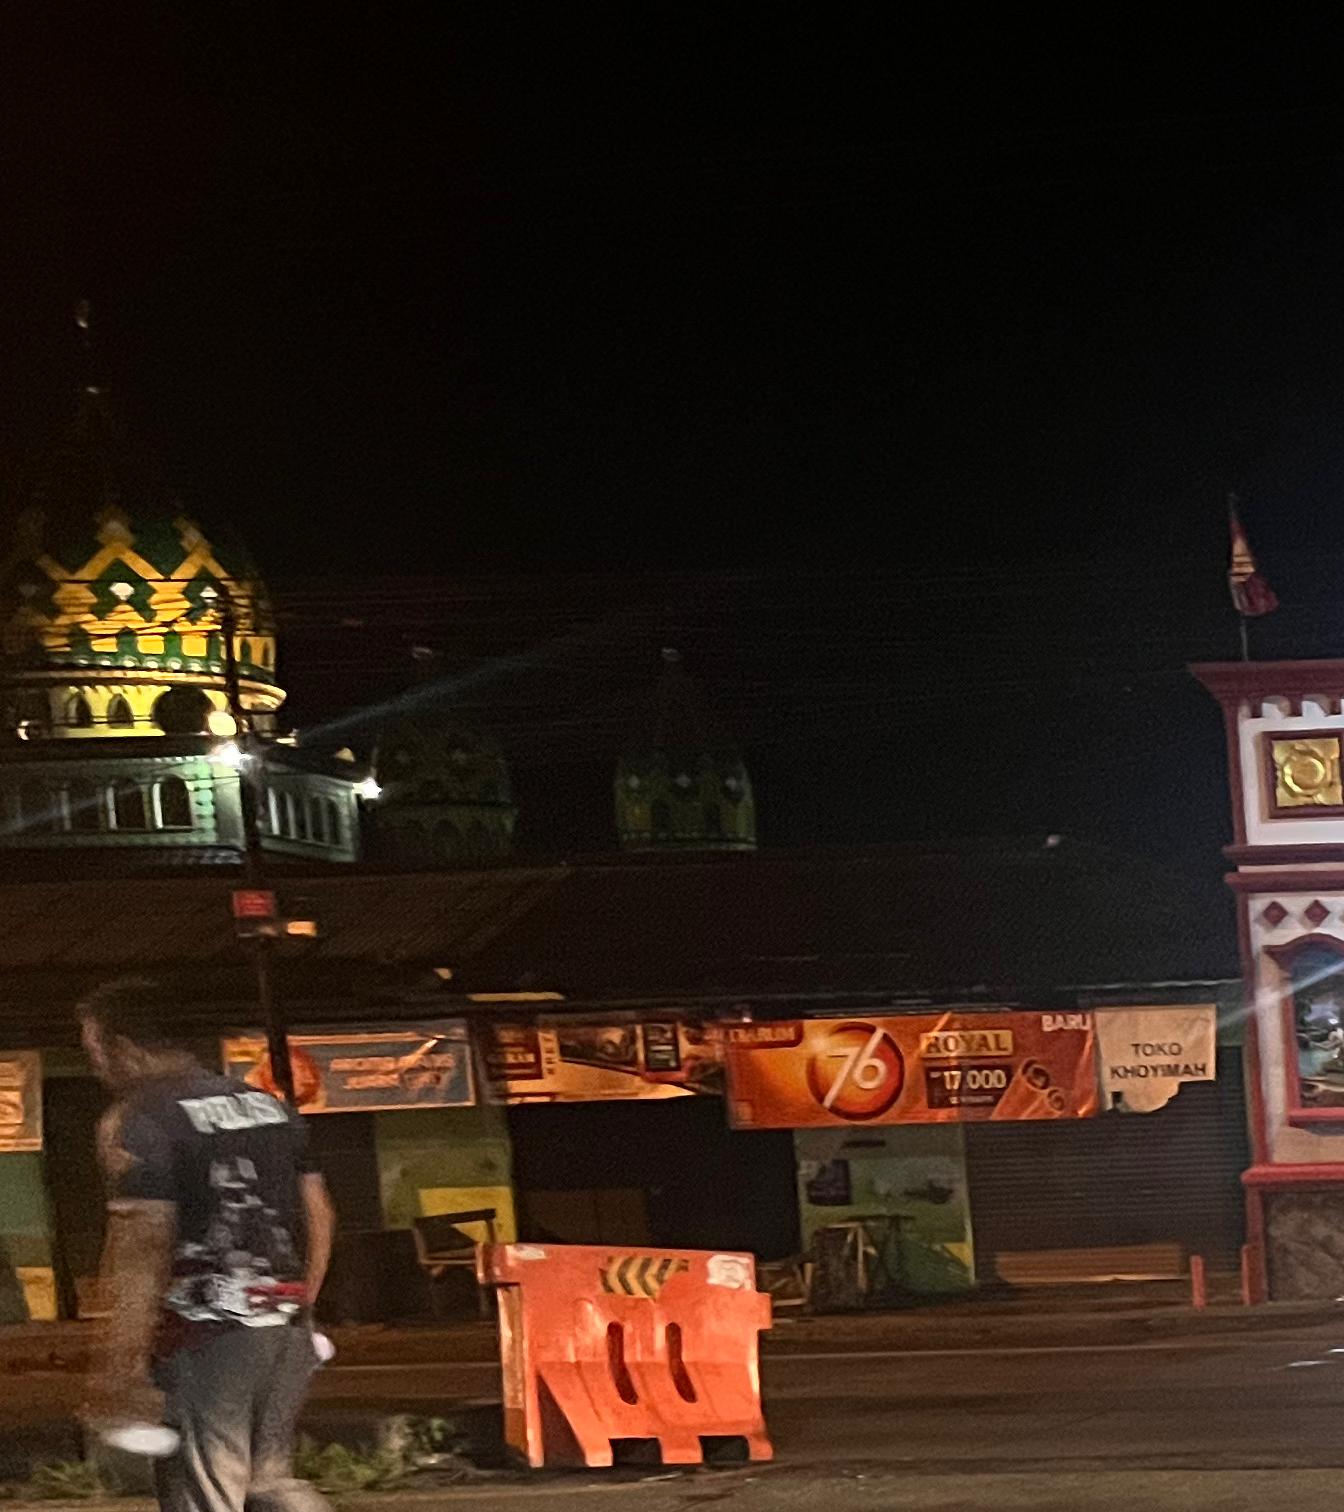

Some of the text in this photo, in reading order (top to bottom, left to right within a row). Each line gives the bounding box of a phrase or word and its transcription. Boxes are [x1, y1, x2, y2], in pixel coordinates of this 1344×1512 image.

[1041, 1013, 1091, 1032] BARU
[928, 1032, 1009, 1053] ROYAL
[1131, 1042, 1184, 1057] TOKO
[1110, 1063, 1207, 1079] KHOYIMAH
